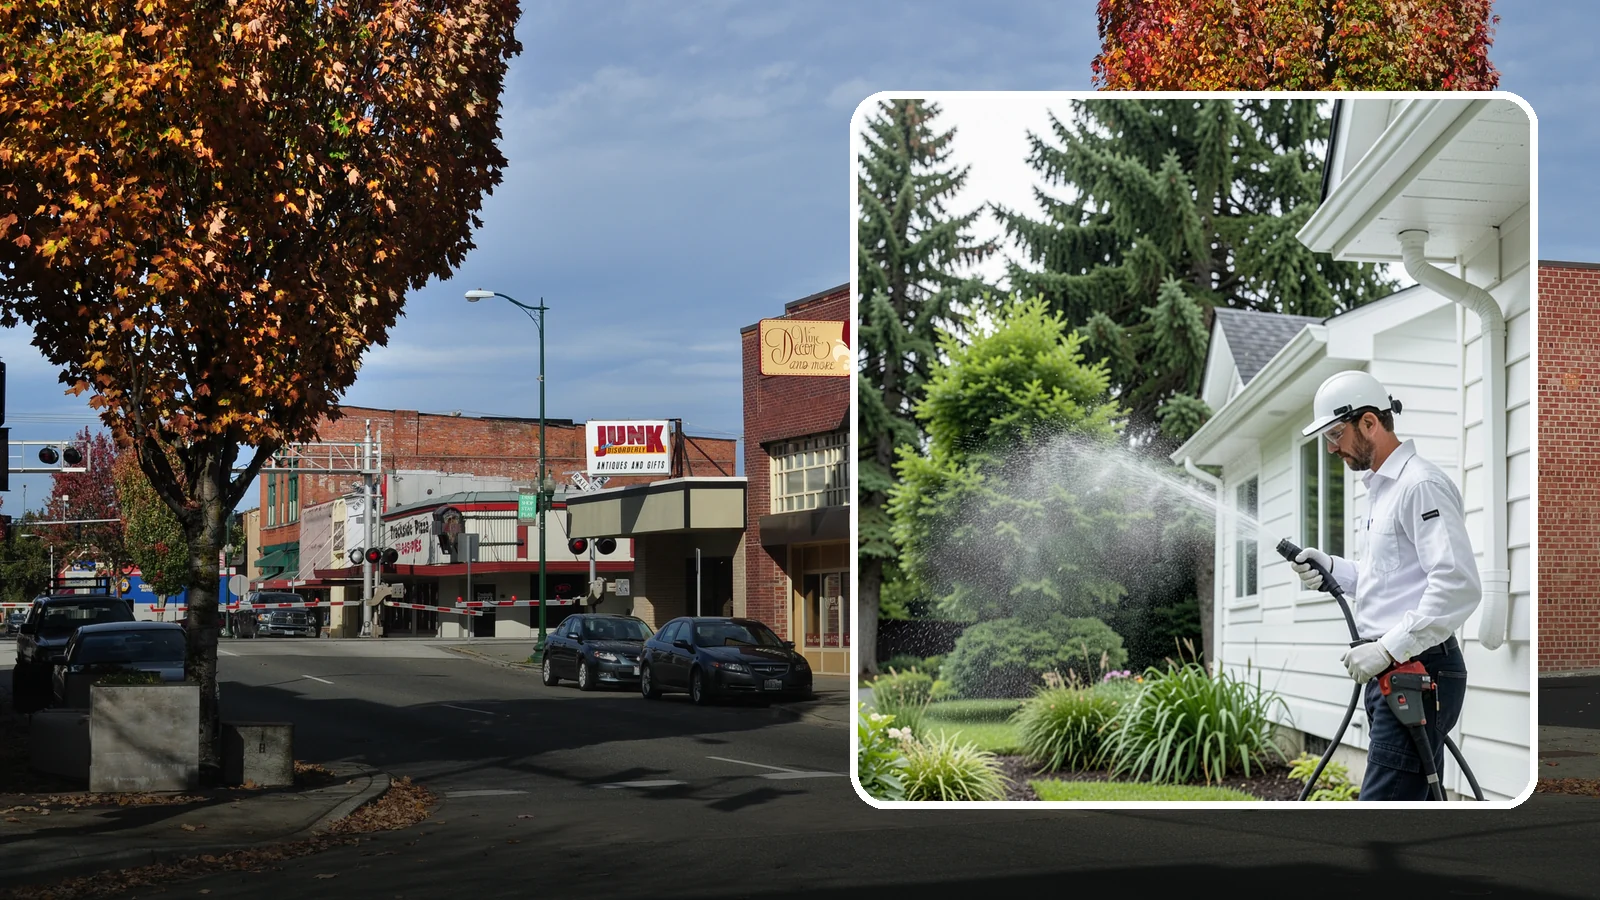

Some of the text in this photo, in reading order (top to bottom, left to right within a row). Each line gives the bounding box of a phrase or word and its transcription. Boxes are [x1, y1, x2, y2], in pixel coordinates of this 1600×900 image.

[595, 425, 666, 457] JUNK
[607, 446, 645, 454] DISORDERLY
[596, 460, 665, 470] ANTIQUES AND GIFTS
[390, 519, 429, 540] Trackside Pizza
